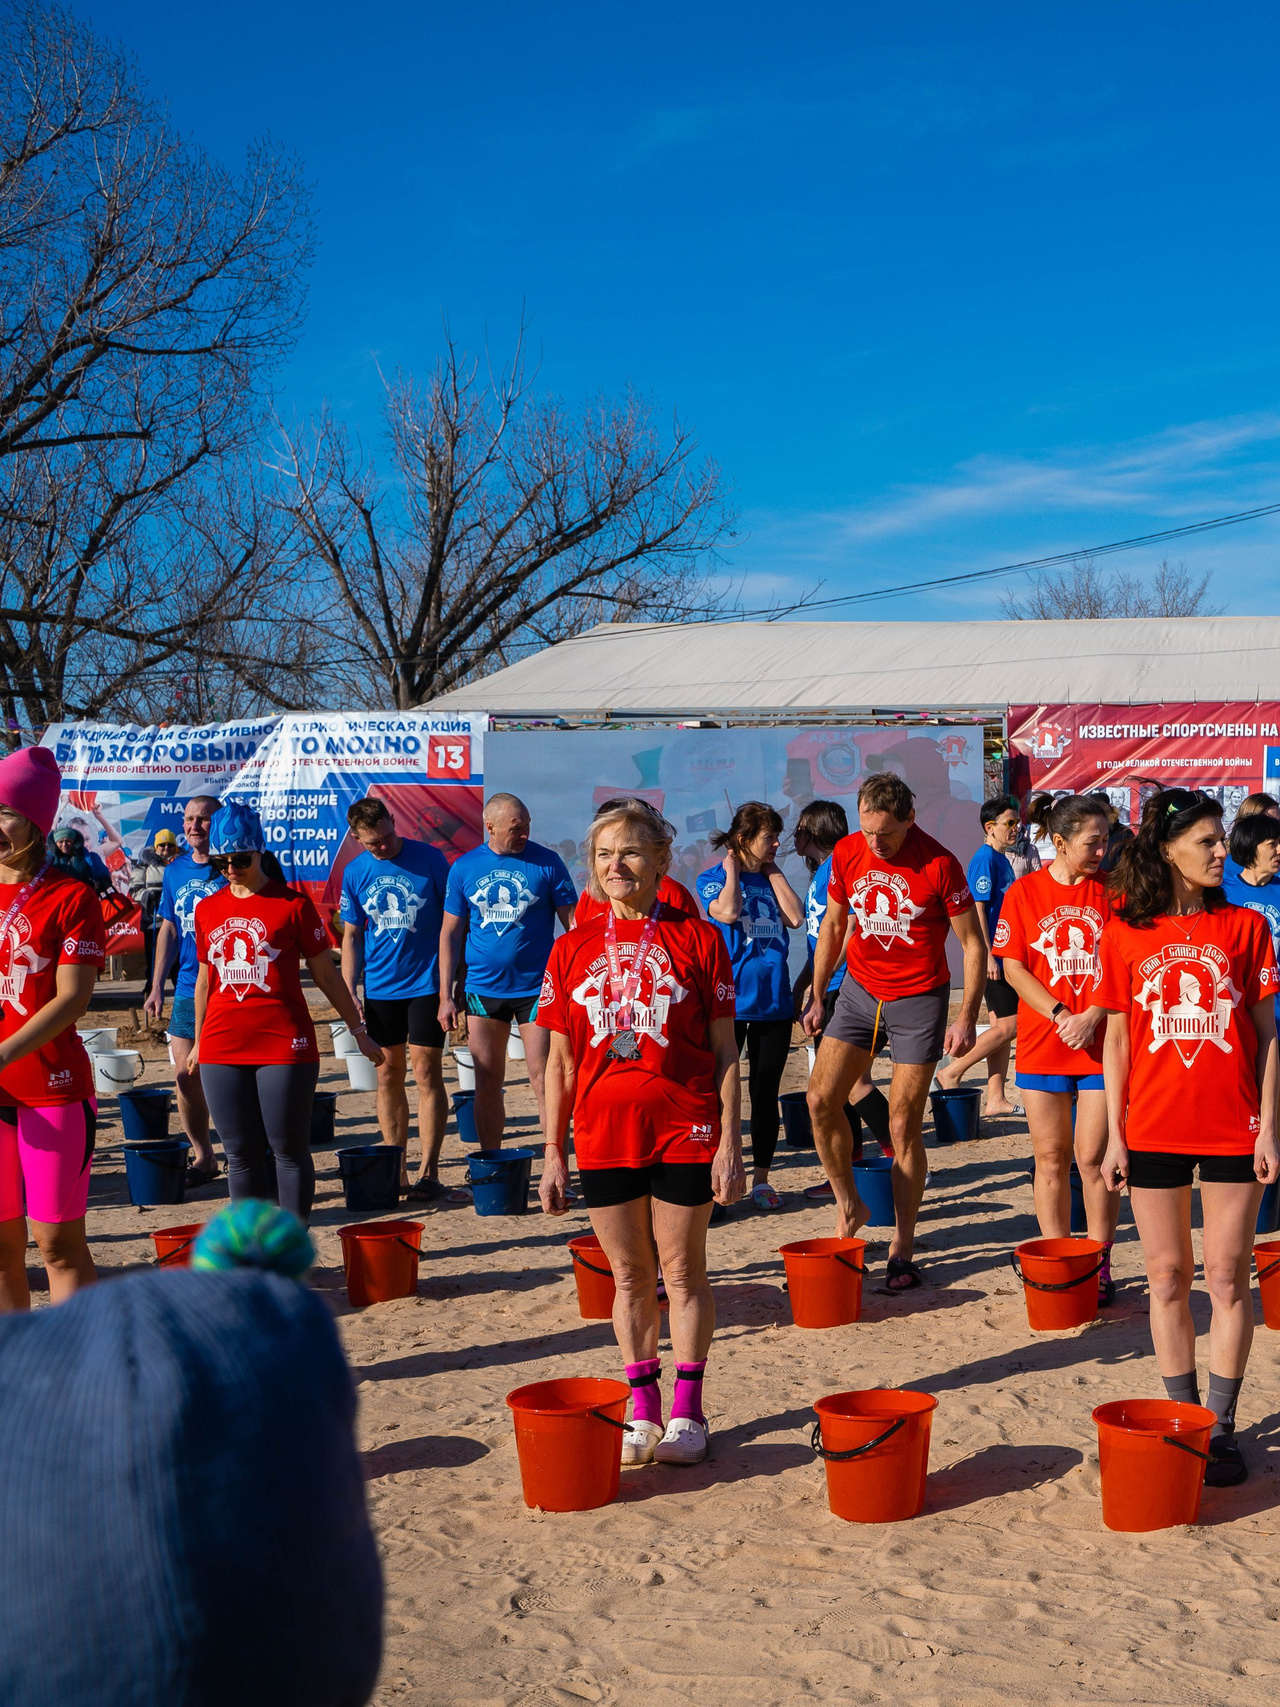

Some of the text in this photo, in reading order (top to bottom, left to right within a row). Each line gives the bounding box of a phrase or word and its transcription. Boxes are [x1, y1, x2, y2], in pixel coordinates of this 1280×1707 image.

[420, 721, 471, 732] АКЦИЯ
[1079, 724, 1159, 739] ИЗВЕСТНЫЕ
[1162, 723, 1257, 738] СПОРТСМЕНЫ
[1260, 723, 1278, 737] НА
[107, 741, 255, 763] ЗДОРОВЫМ
[326, 735, 421, 755] МОДНО
[434, 745, 464, 769] 13
[116, 764, 172, 774] 80-ЛЕТИЮ
[175, 764, 226, 773] ПОБЕДЫ
[230, 764, 237, 772] В
[383, 757, 420, 766] ВОЙНЕ
[1097, 756, 1253, 769] В ГОДЫ ВЕЛИКОЙ ОТЕЧЕСТВЕННОЙ ВОЙНЫ
[250, 794, 338, 808] ОБЛИВАНИЕ
[266, 805, 318, 820] ВОДОЙ
[264, 826, 338, 843] 10 СТРАН
[78, 940, 98, 949] ПУТЬ
[650, 945, 668, 965] ДОЛГ
[1143, 945, 1226, 975] СИЛА СЛАВА ДОЛГ
[1157, 1014, 1219, 1034] ЯРОПОЛК
[48, 1078, 74, 1087] SPORT
